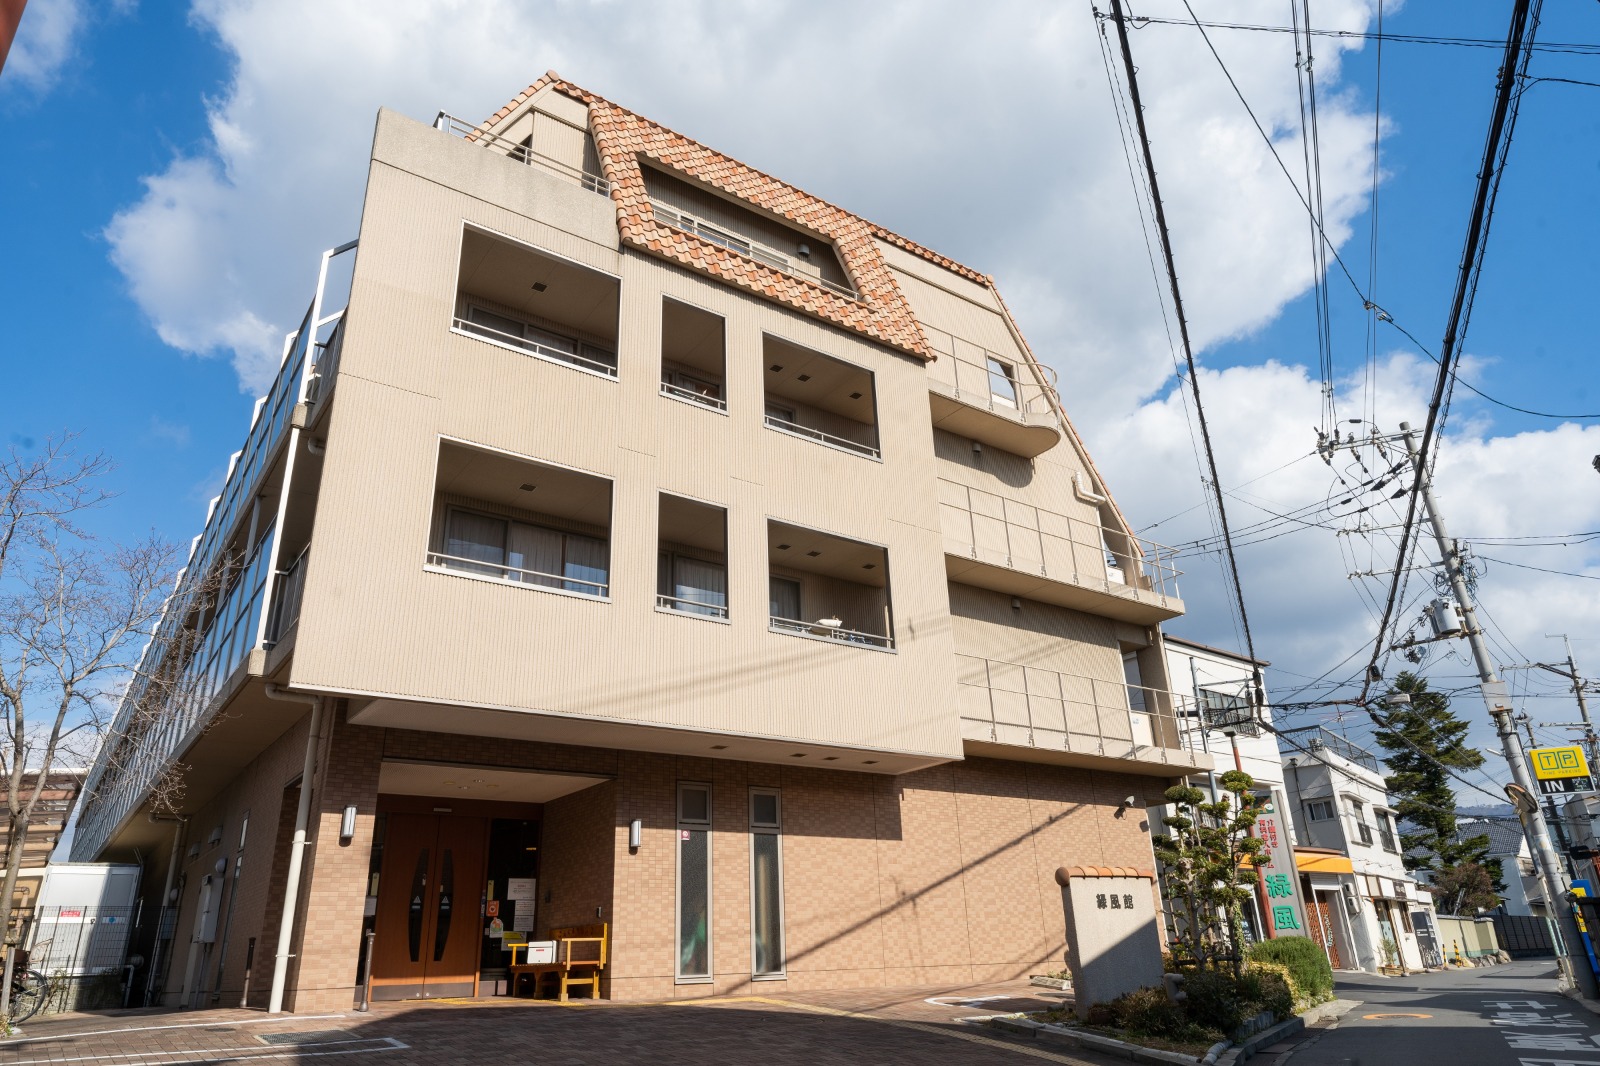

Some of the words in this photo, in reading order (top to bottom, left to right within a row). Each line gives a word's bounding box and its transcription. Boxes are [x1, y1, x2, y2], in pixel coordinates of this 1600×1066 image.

[1544, 780, 1565, 792] IN
[1258, 819, 1275, 869] 有料老人ホム
[1265, 873, 1300, 930] 緑風
